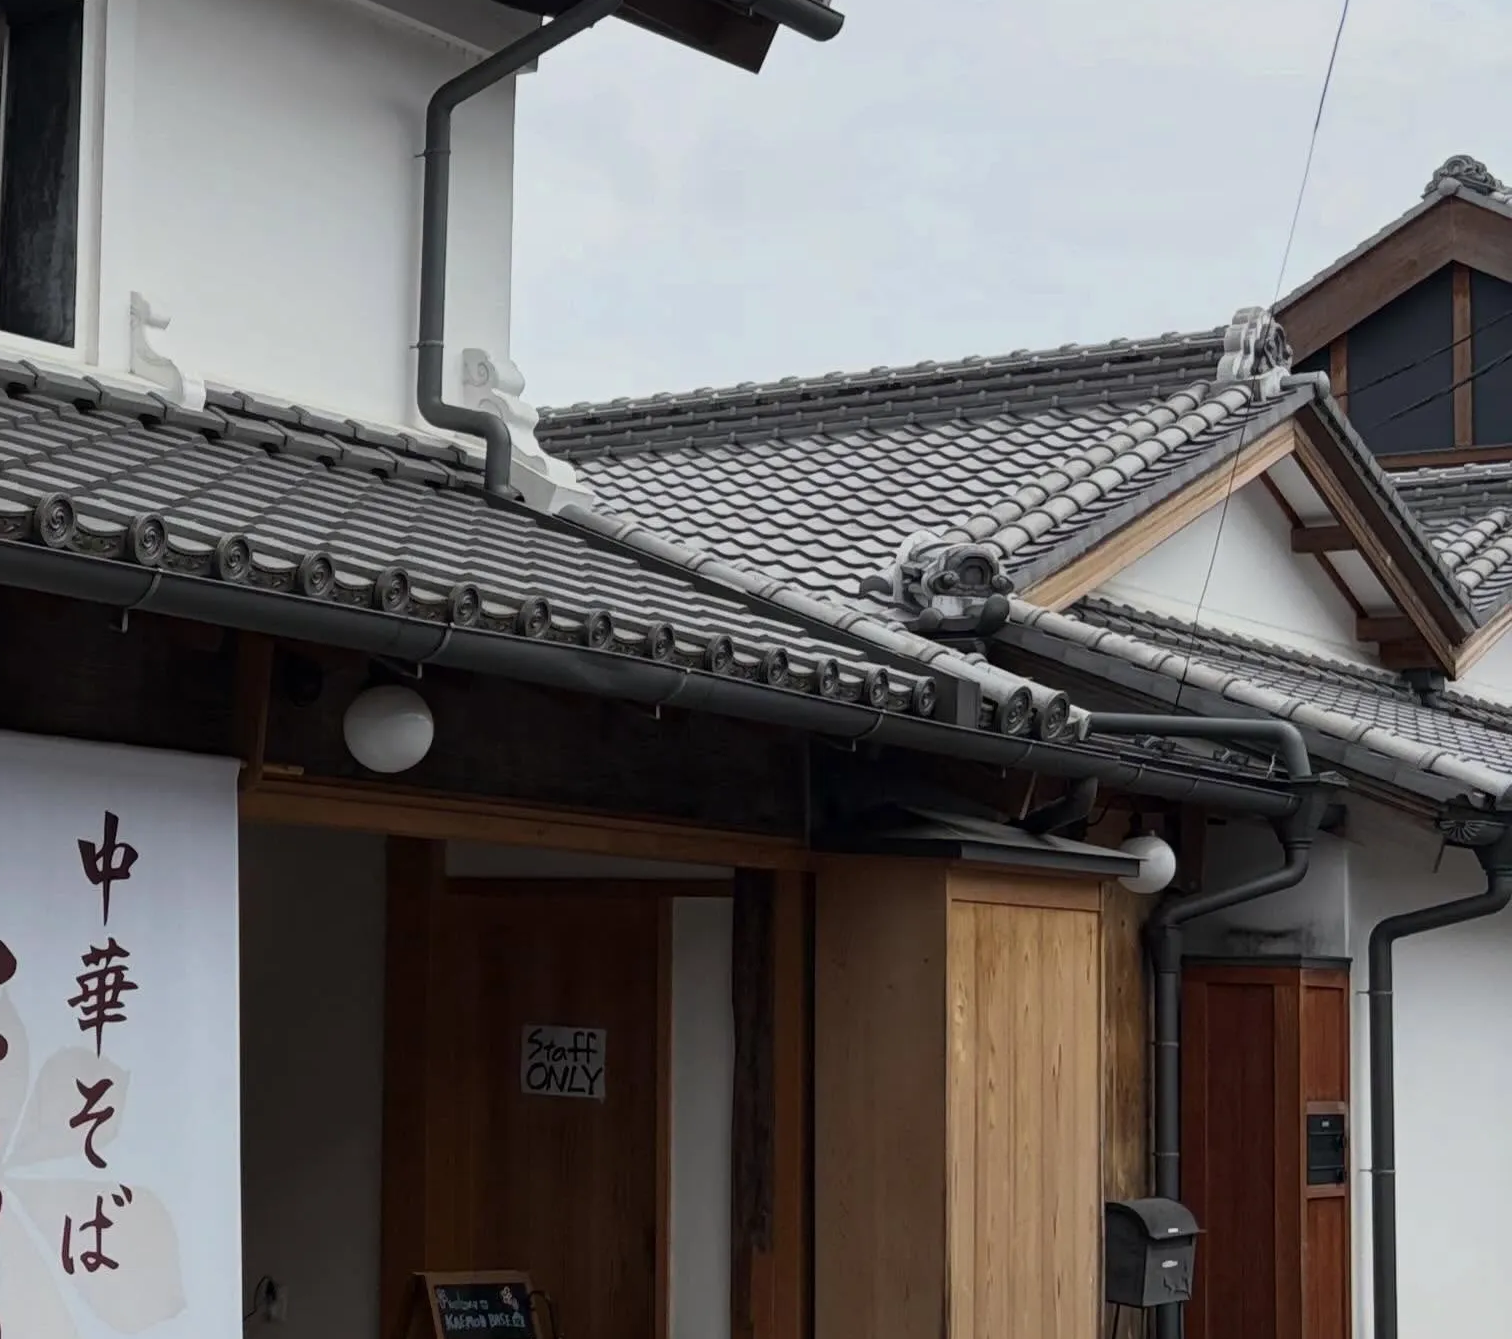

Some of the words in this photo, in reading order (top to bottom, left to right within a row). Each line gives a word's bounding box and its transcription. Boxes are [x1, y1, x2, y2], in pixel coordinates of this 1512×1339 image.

[61, 809, 139, 1274] 中華そば
[527, 1028, 598, 1062] Staff
[526, 1062, 603, 1095] ONLY
